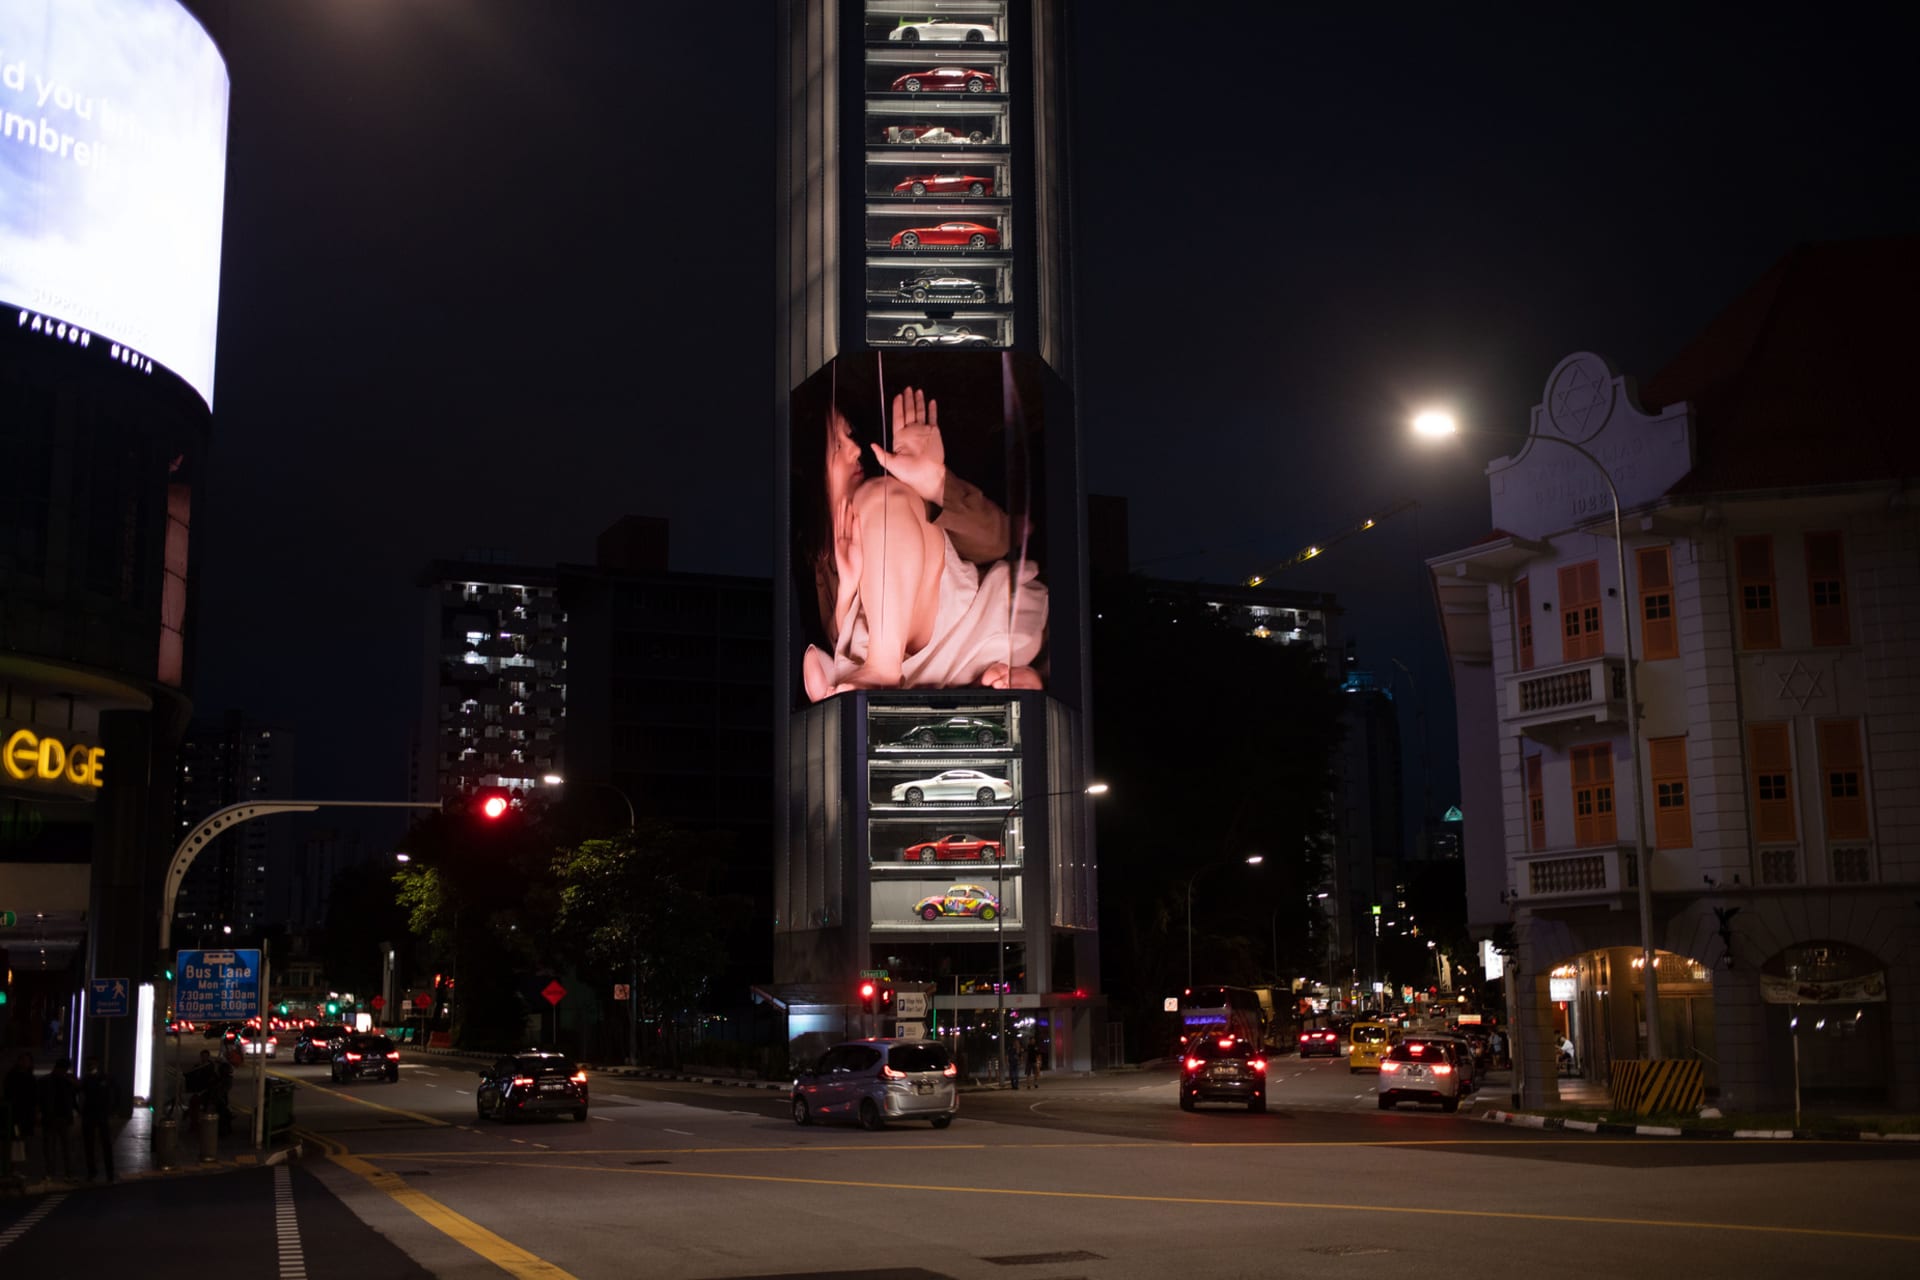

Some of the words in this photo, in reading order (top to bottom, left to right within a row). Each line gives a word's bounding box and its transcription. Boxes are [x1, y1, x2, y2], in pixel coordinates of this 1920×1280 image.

[35, 74, 92, 121] you
[110, 342, 153, 375] MEDIA
[3, 728, 106, 788] EDGE
[186, 964, 211, 979] Bus
[219, 964, 251, 979] Lane
